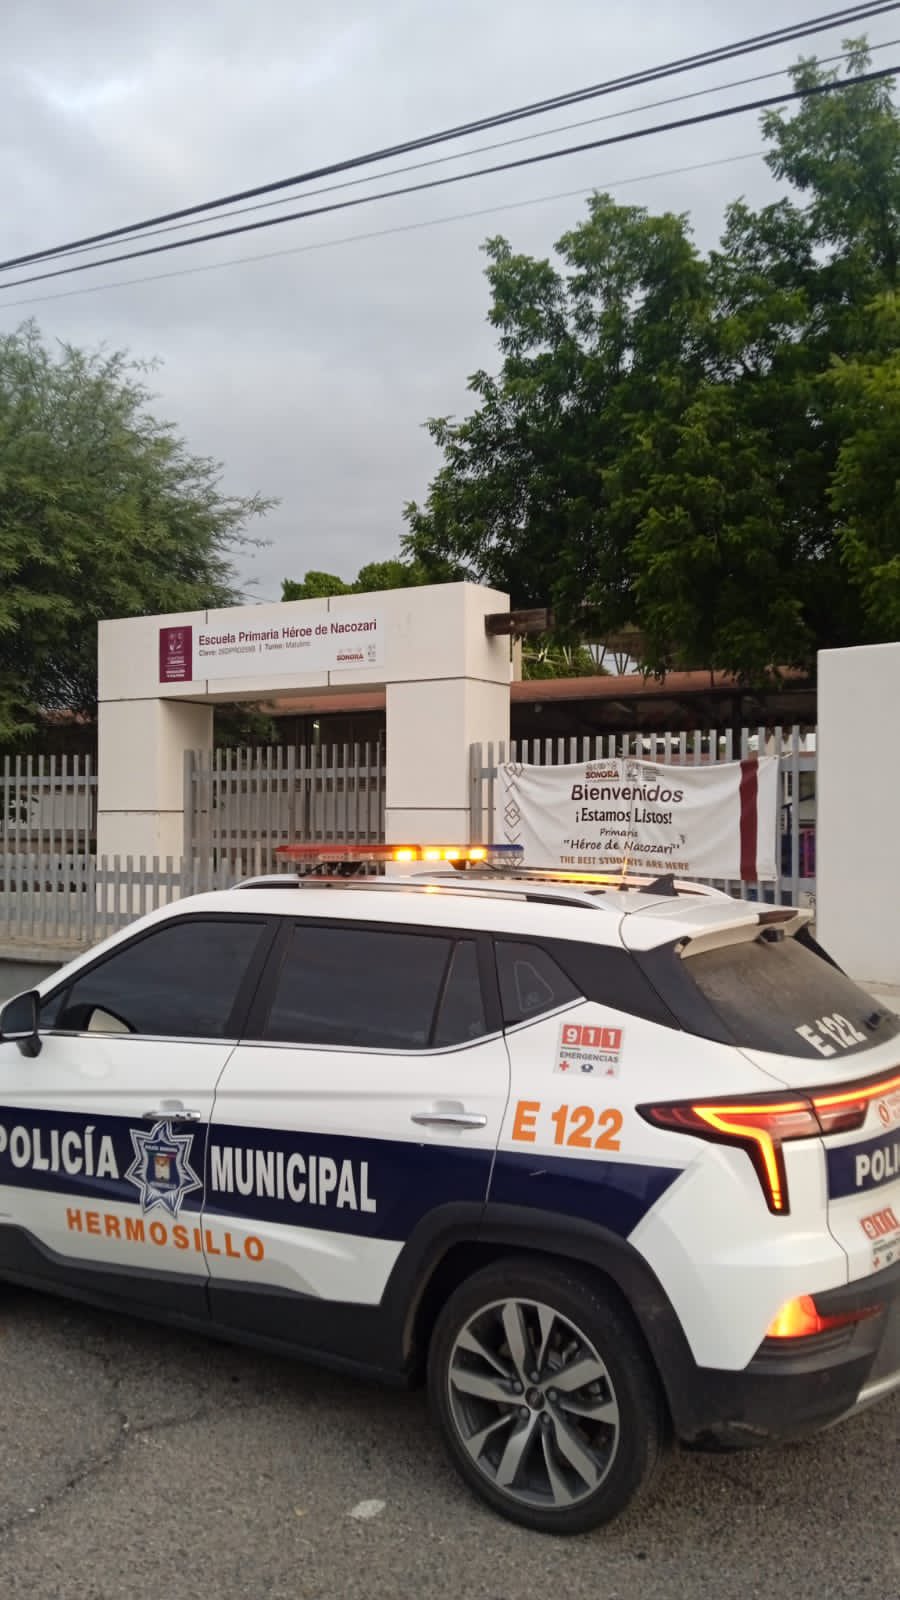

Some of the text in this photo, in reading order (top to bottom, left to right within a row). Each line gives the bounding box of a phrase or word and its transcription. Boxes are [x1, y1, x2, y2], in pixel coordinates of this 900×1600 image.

[199, 619, 377, 646] Escuela Primaria Héroe de Nacozari
[585, 769, 619, 779] SONORA
[571, 784, 684, 803] Bienvenidos
[575, 807, 673, 825] ¡Estamos Listos!
[604, 839, 619, 850] de
[560, 855, 575, 864] THE
[577, 856, 596, 864] BEST
[645, 861, 663, 869] ARE
[564, 1026, 619, 1048] 911
[794, 1013, 868, 1056] E 122
[559, 1051, 619, 1063] EMERGENCIAS
[512, 1100, 623, 1152] E 122
[856, 1143, 900, 1186] POLI
[211, 1145, 377, 1213] MUNICIPAL
[66, 1207, 265, 1262] HERMOSILLO
[862, 1208, 897, 1240] 911
